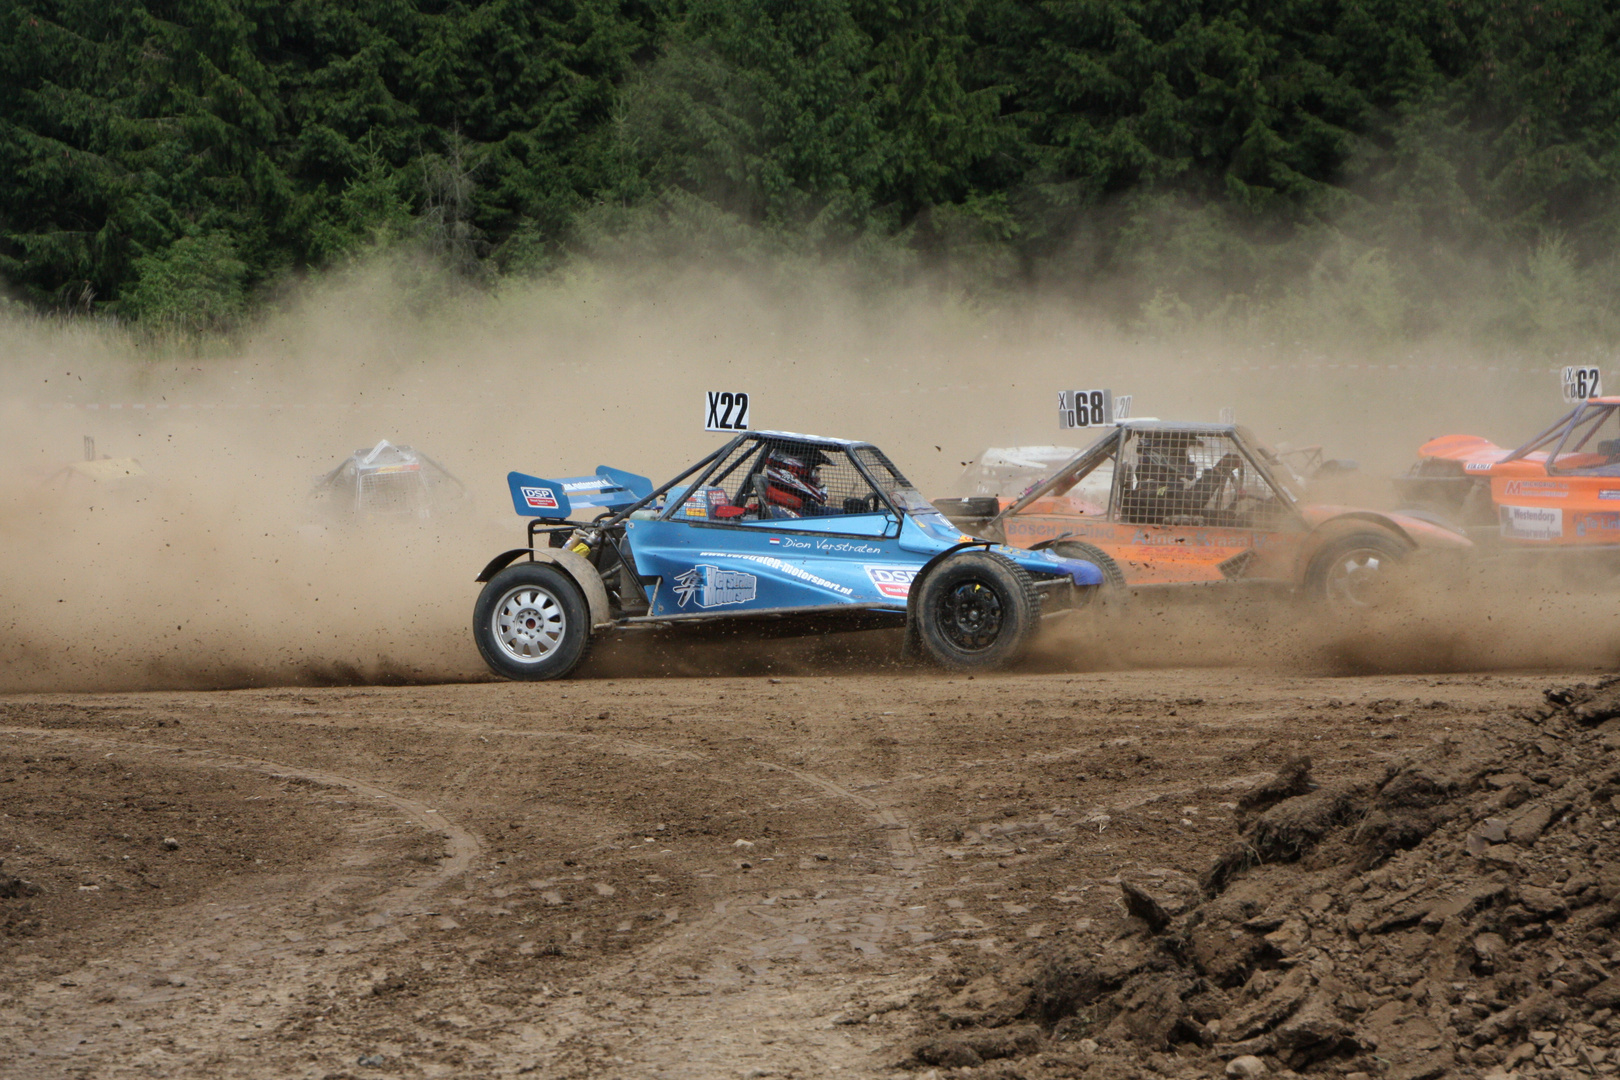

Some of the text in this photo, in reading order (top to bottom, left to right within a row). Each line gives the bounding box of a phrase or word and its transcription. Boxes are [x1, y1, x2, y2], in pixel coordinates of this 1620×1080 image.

[1577, 369, 1599, 399] 62
[707, 391, 748, 429] X22
[1058, 392, 1066, 410] X
[1075, 391, 1104, 427] 68
[525, 489, 550, 498] DSP
[1513, 508, 1555, 524] Westendorp
[783, 537, 881, 554] Dion Verstraten
